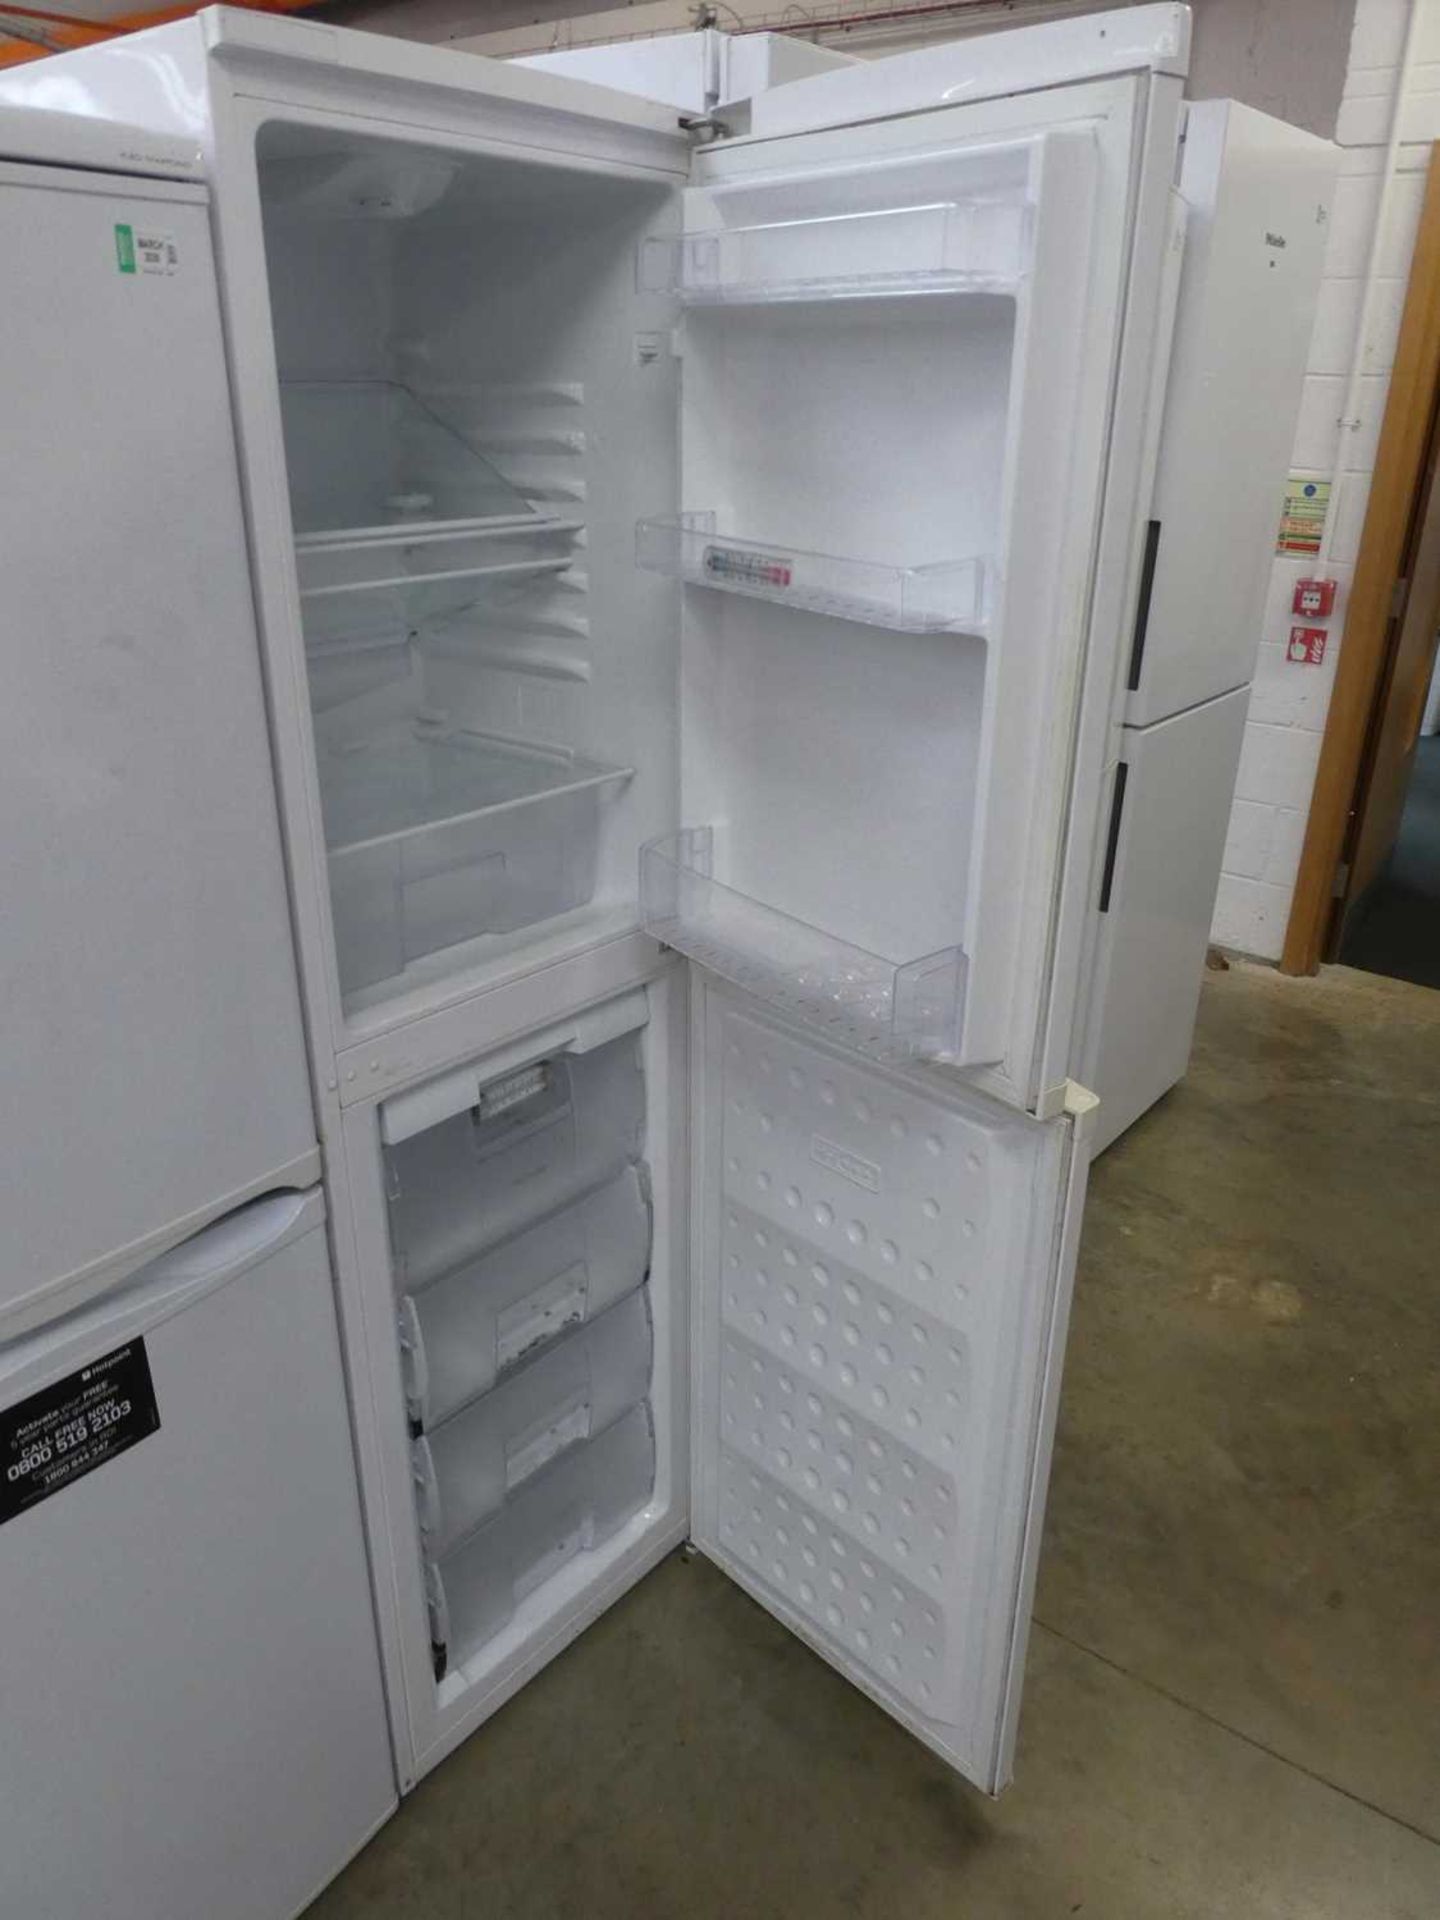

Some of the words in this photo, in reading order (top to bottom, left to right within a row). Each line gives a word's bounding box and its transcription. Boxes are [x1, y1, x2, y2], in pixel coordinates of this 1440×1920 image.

[92, 1349, 131, 1375] Hotpoint
[16, 1409, 59, 1438] Activate
[83, 1380, 108, 1399] FREE
[21, 1436, 53, 1457] CALL
[54, 1416, 86, 1439] FREE
[88, 1398, 115, 1419] NOW
[7, 1448, 51, 1481] 0800
[56, 1427, 87, 1453] 519
[92, 1400, 131, 1432] 2103
